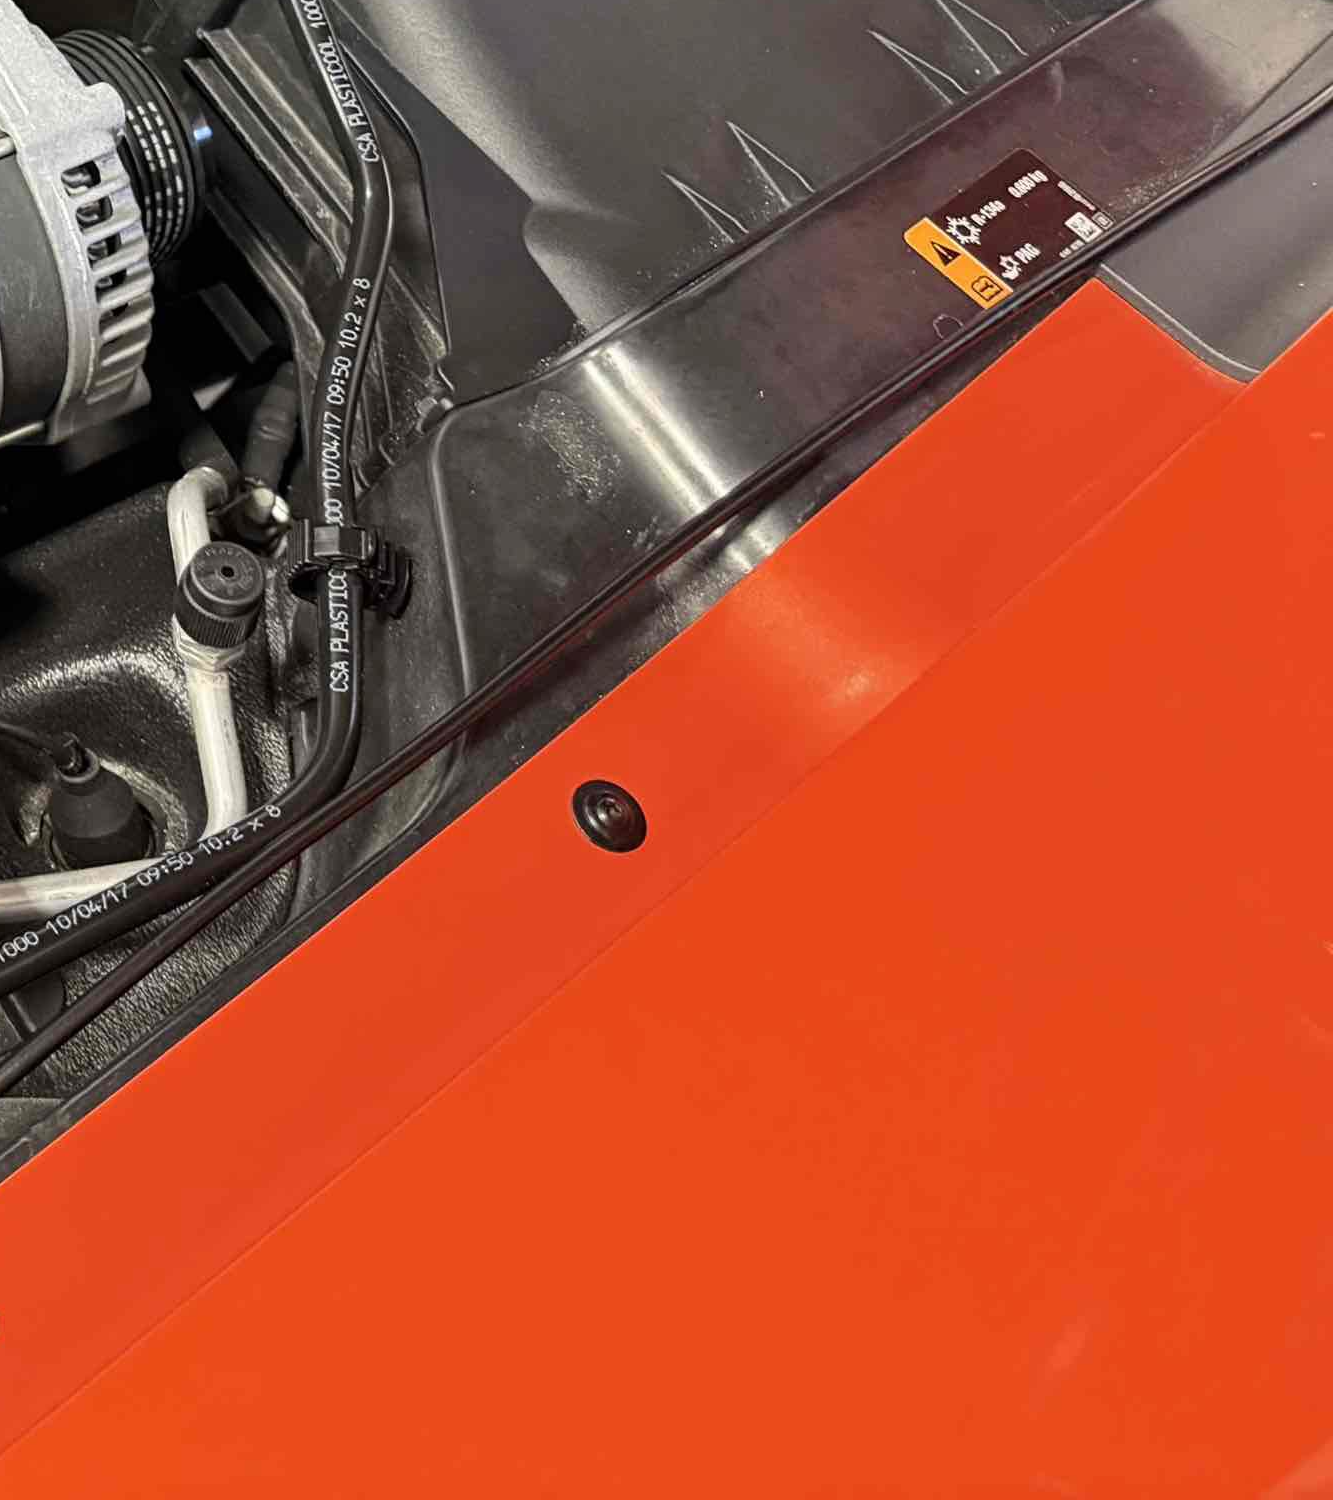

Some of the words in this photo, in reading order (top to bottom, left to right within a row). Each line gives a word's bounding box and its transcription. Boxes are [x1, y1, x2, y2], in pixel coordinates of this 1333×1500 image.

[317, 36, 368, 127] PLASTICOOL
[356, 132, 380, 162] CSA
[1014, 243, 1042, 264] PAG
[353, 277, 372, 290] 8
[339, 312, 363, 349] 10.2
[326, 355, 353, 406] 09:50
[322, 411, 343, 491] 10/04/17
[329, 660, 349, 693] CSA
[45, 882, 129, 936] 10/04/17
[136, 851, 195, 887] 09:50
[198, 827, 245, 855] 10.2
[264, 804, 282, 818] 8
